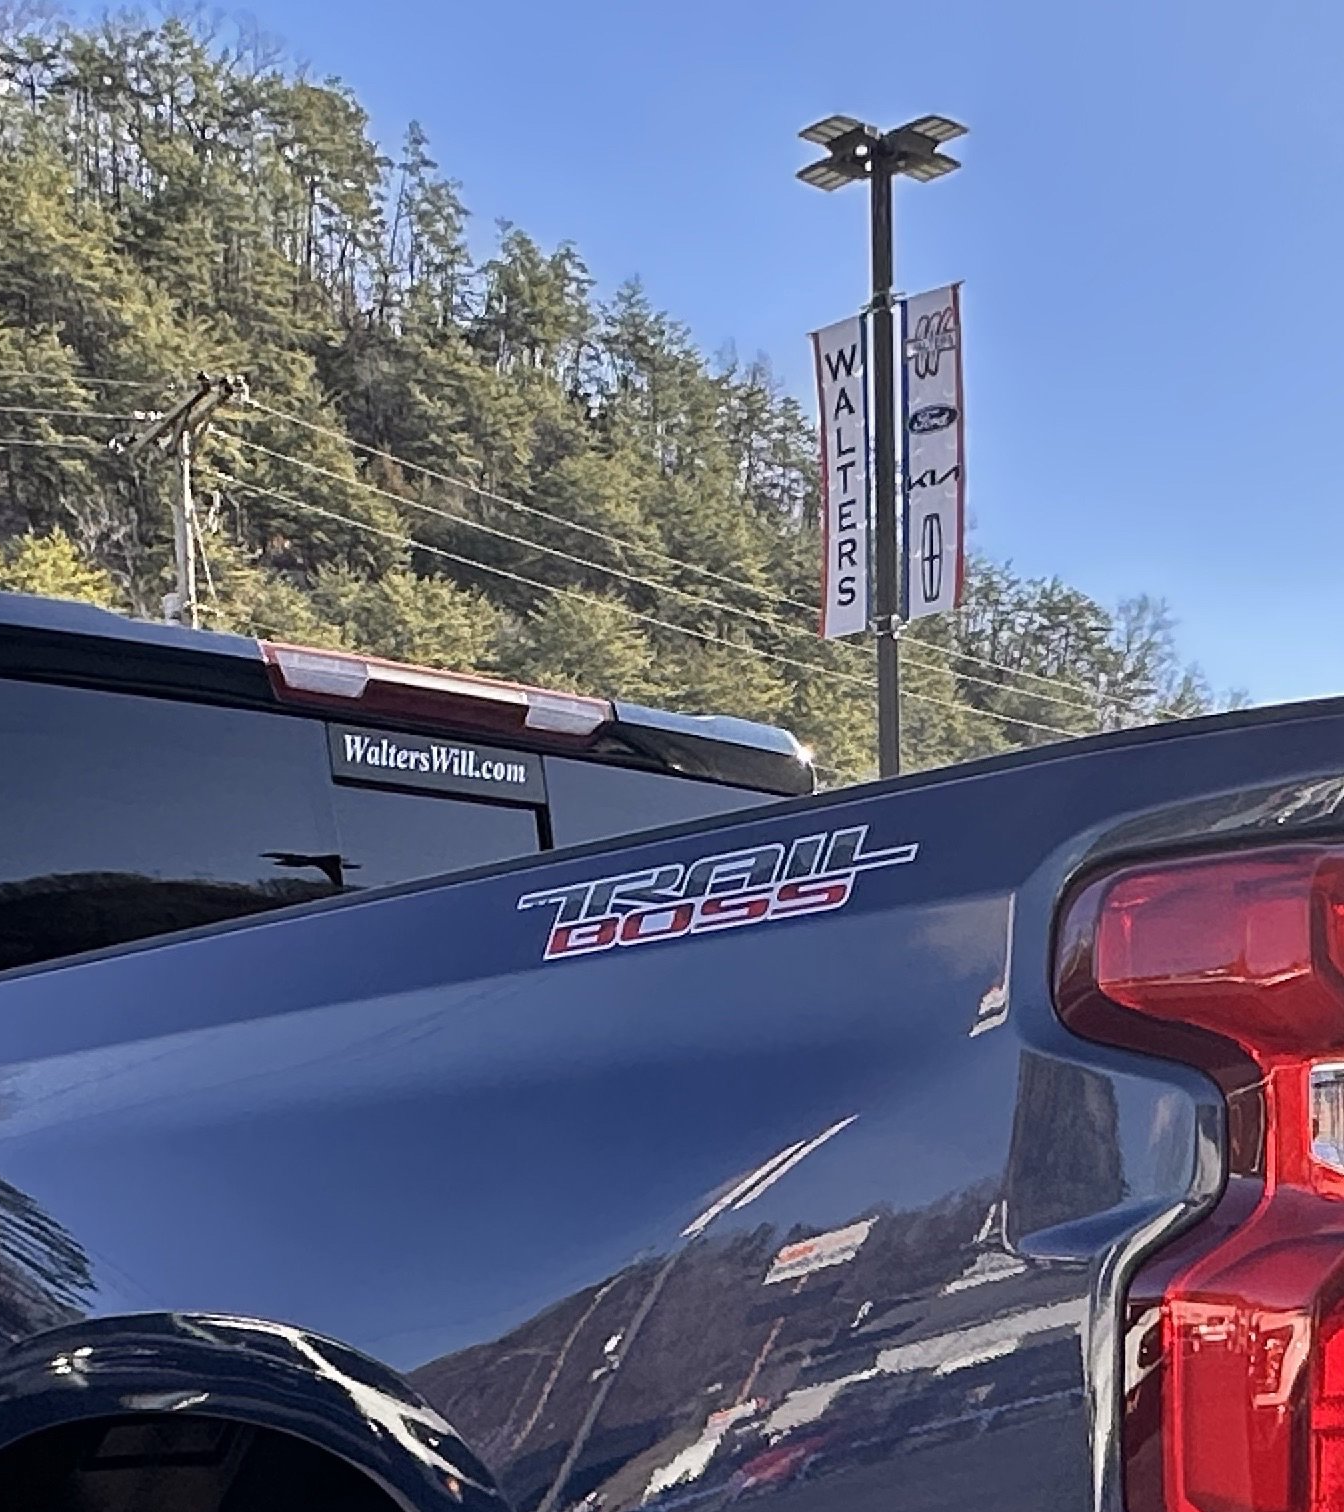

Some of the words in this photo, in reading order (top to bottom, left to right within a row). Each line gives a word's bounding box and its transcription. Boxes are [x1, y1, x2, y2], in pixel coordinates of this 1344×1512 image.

[824, 345, 858, 607] WALTERS
[342, 733, 527, 785] WaltersWill.com
[517, 824, 919, 925] TRAIL
[542, 873, 856, 963] BOSS
